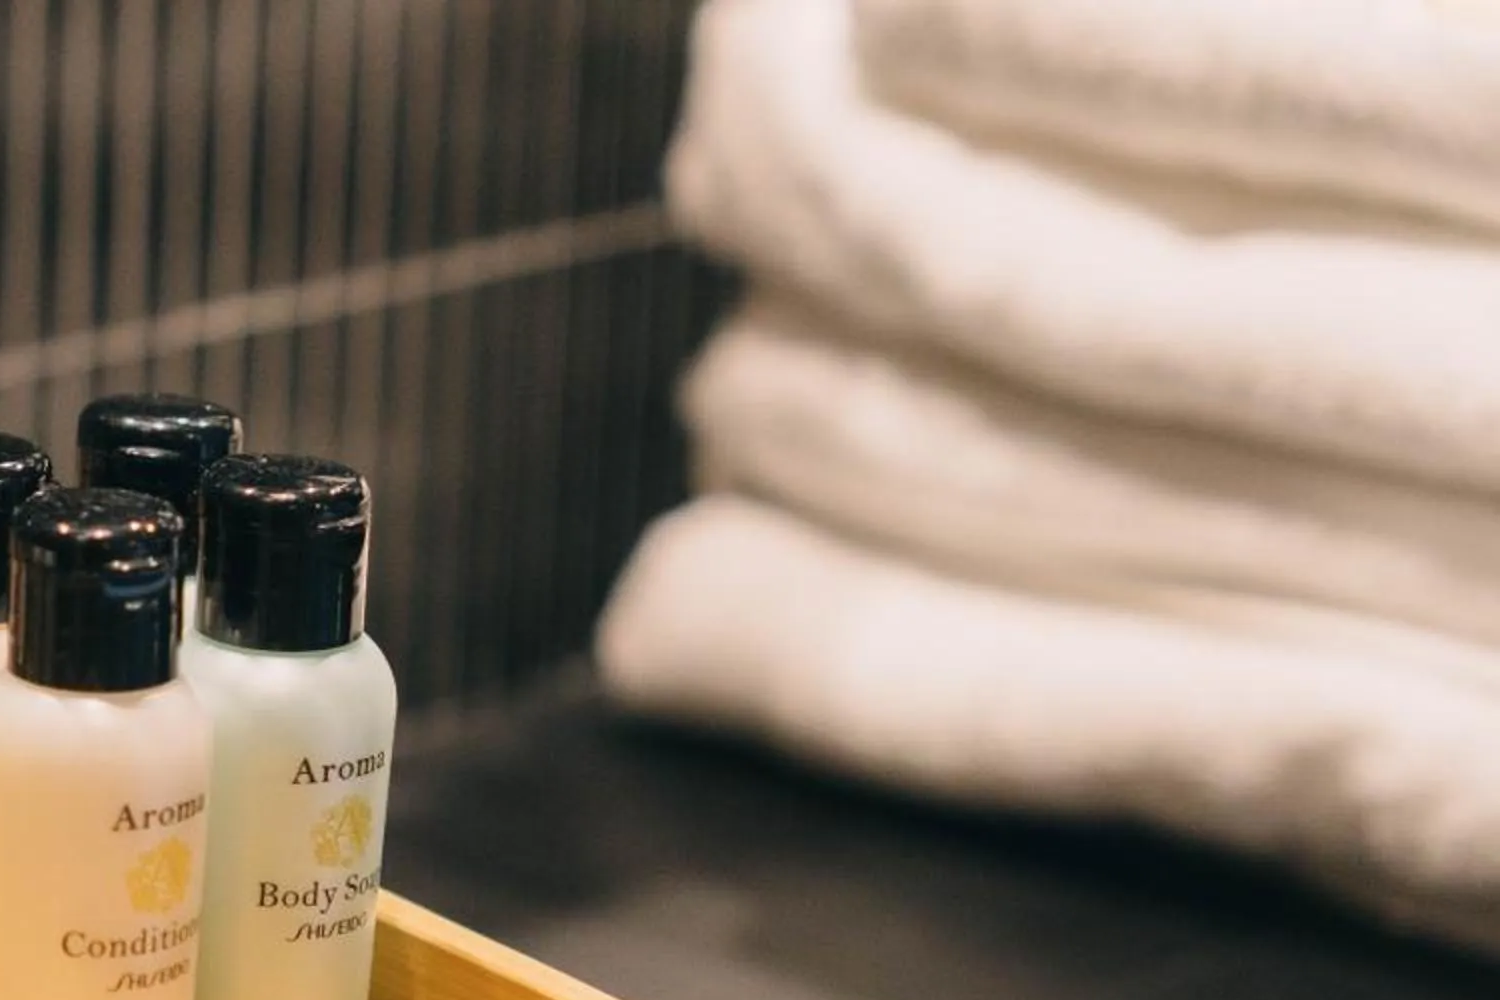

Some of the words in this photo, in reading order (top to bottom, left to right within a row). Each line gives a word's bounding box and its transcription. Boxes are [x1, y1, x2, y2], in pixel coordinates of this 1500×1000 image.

[292, 751, 385, 785] Aroma
[258, 881, 336, 914] Body
[344, 867, 381, 900] Soa
